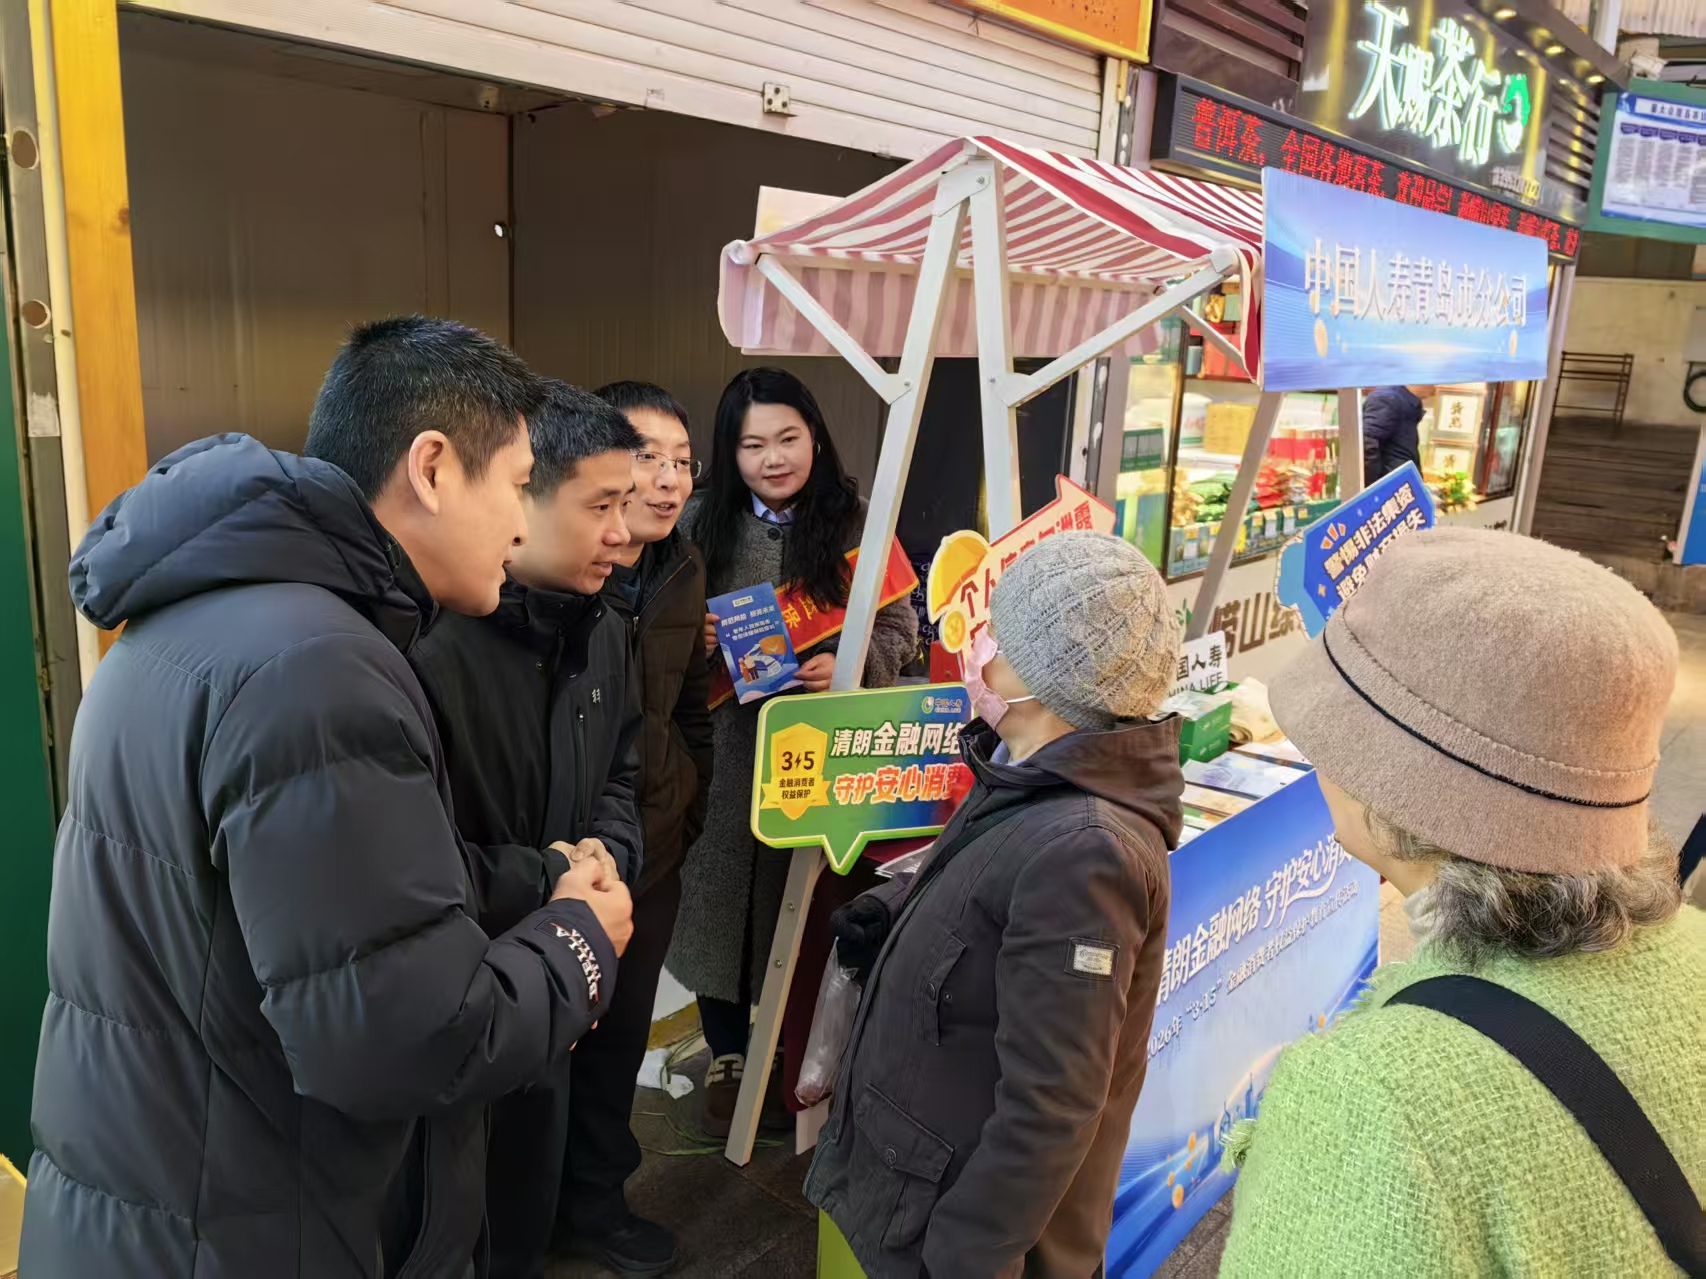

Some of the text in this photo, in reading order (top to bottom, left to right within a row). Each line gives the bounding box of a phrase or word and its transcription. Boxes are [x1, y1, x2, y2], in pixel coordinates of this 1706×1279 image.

[1304, 238, 1528, 328] 中国人寿青岛市分公司
[1323, 482, 1416, 580] 警惕非法集资
[779, 777, 815, 788] 金融消费者
[782, 789, 810, 799] 权益保护
